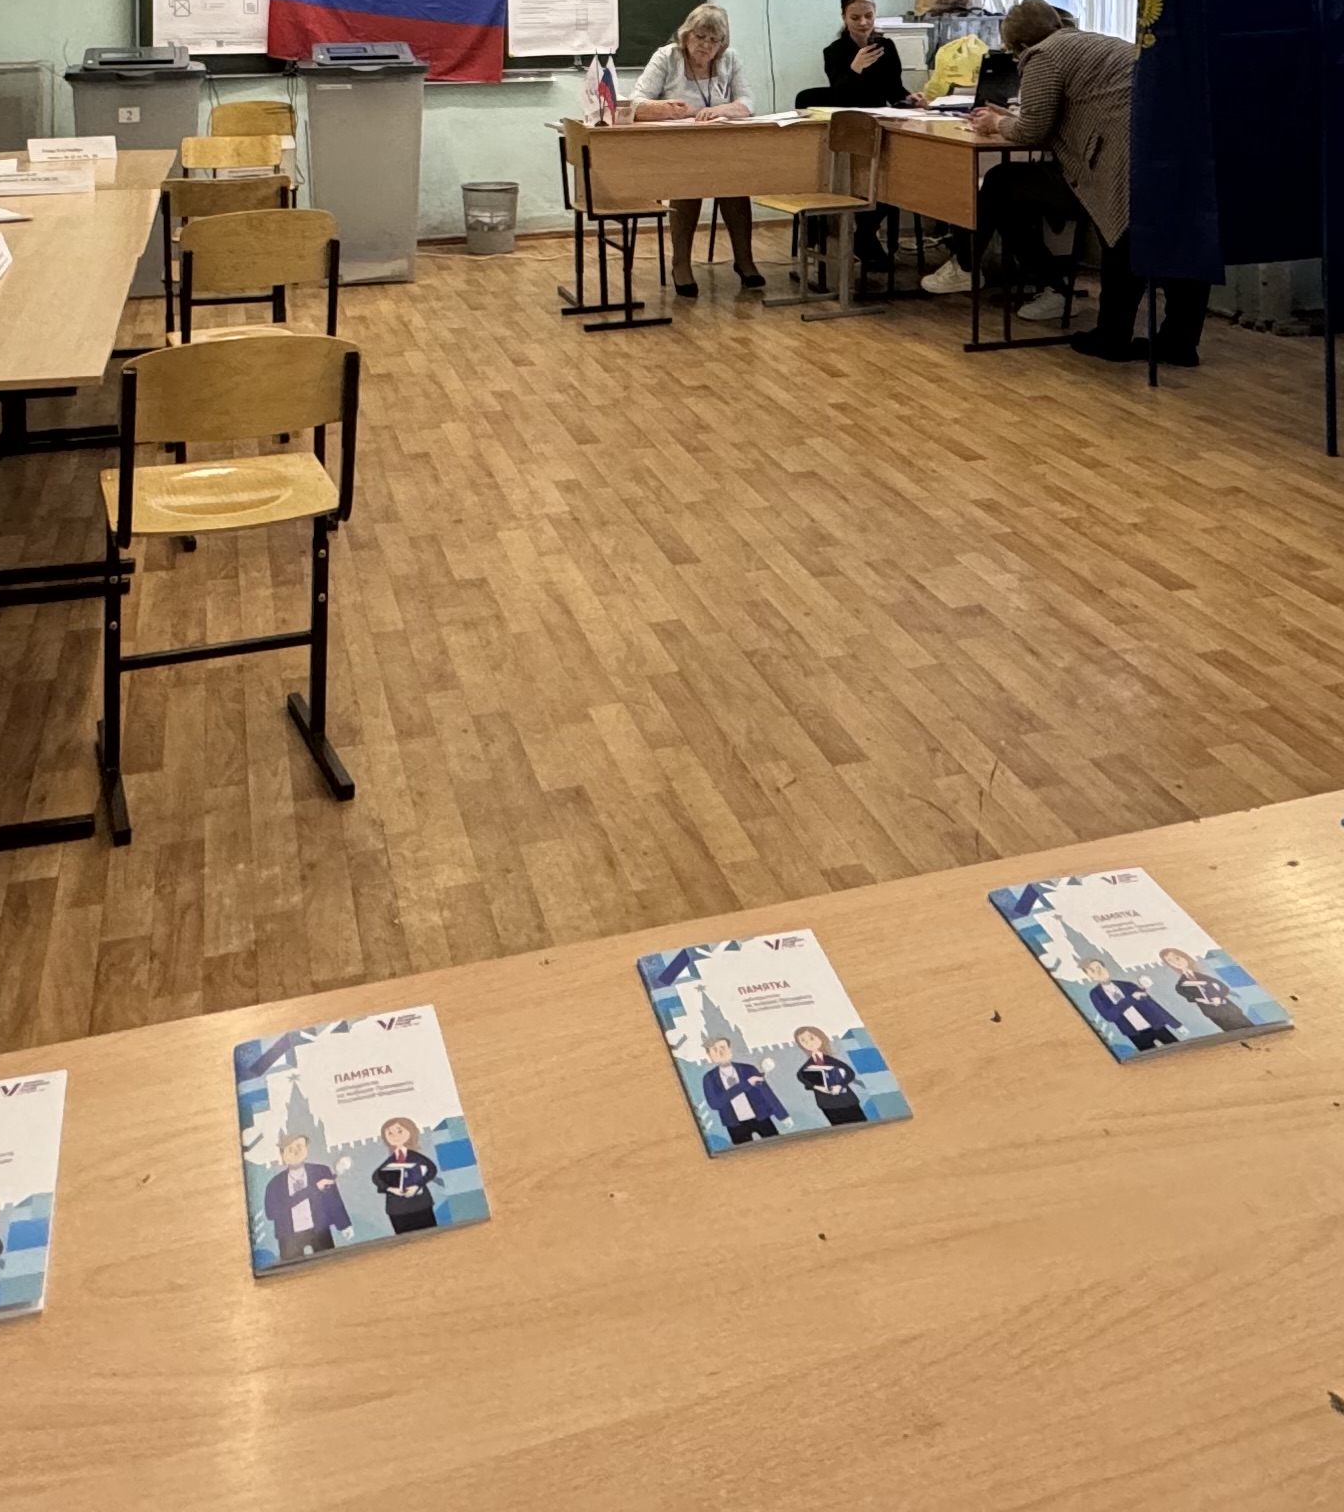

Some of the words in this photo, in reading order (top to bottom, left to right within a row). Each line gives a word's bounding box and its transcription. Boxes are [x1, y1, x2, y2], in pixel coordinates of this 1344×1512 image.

[125, 110, 133, 121] 2
[737, 980, 791, 995] ПАМЯТКА
[333, 1064, 393, 1084] ПАМЯТКА
